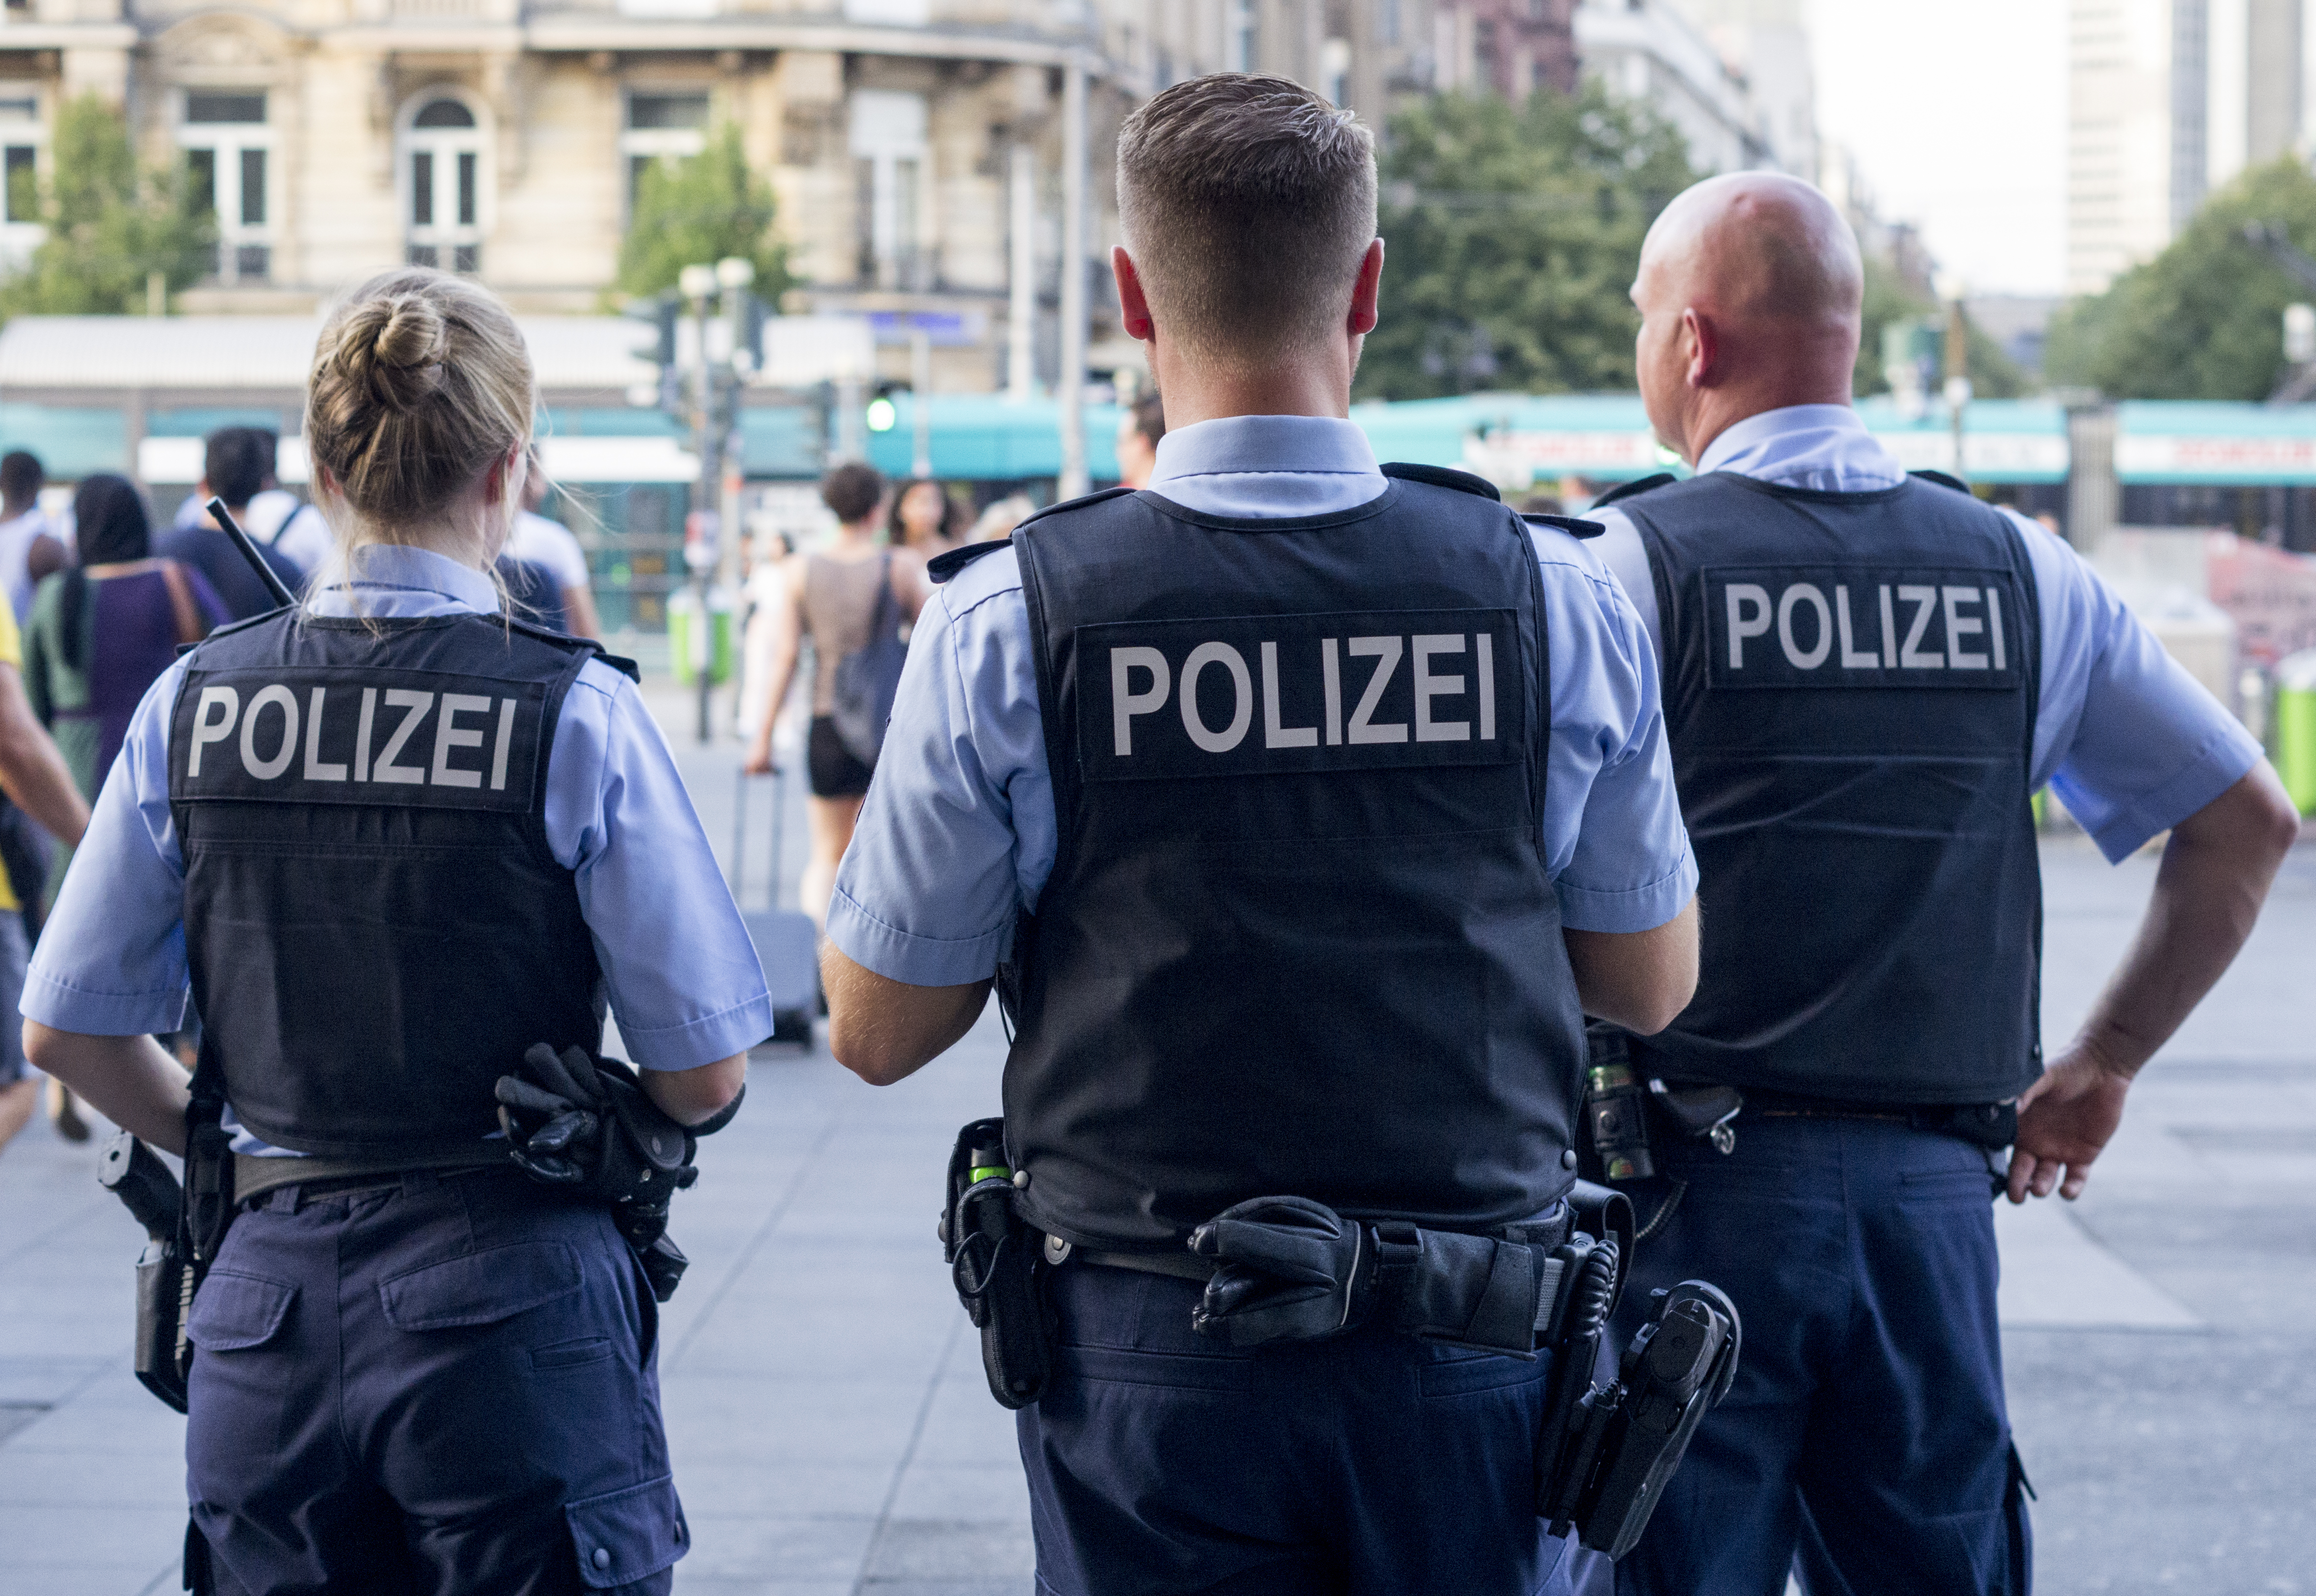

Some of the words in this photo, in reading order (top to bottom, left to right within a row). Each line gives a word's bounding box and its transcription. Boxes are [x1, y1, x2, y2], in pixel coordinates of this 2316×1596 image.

[1726, 583, 2006, 669] POLIZEI
[188, 685, 517, 790] POLIZEI
[1111, 634, 1495, 755] POLIZEI
